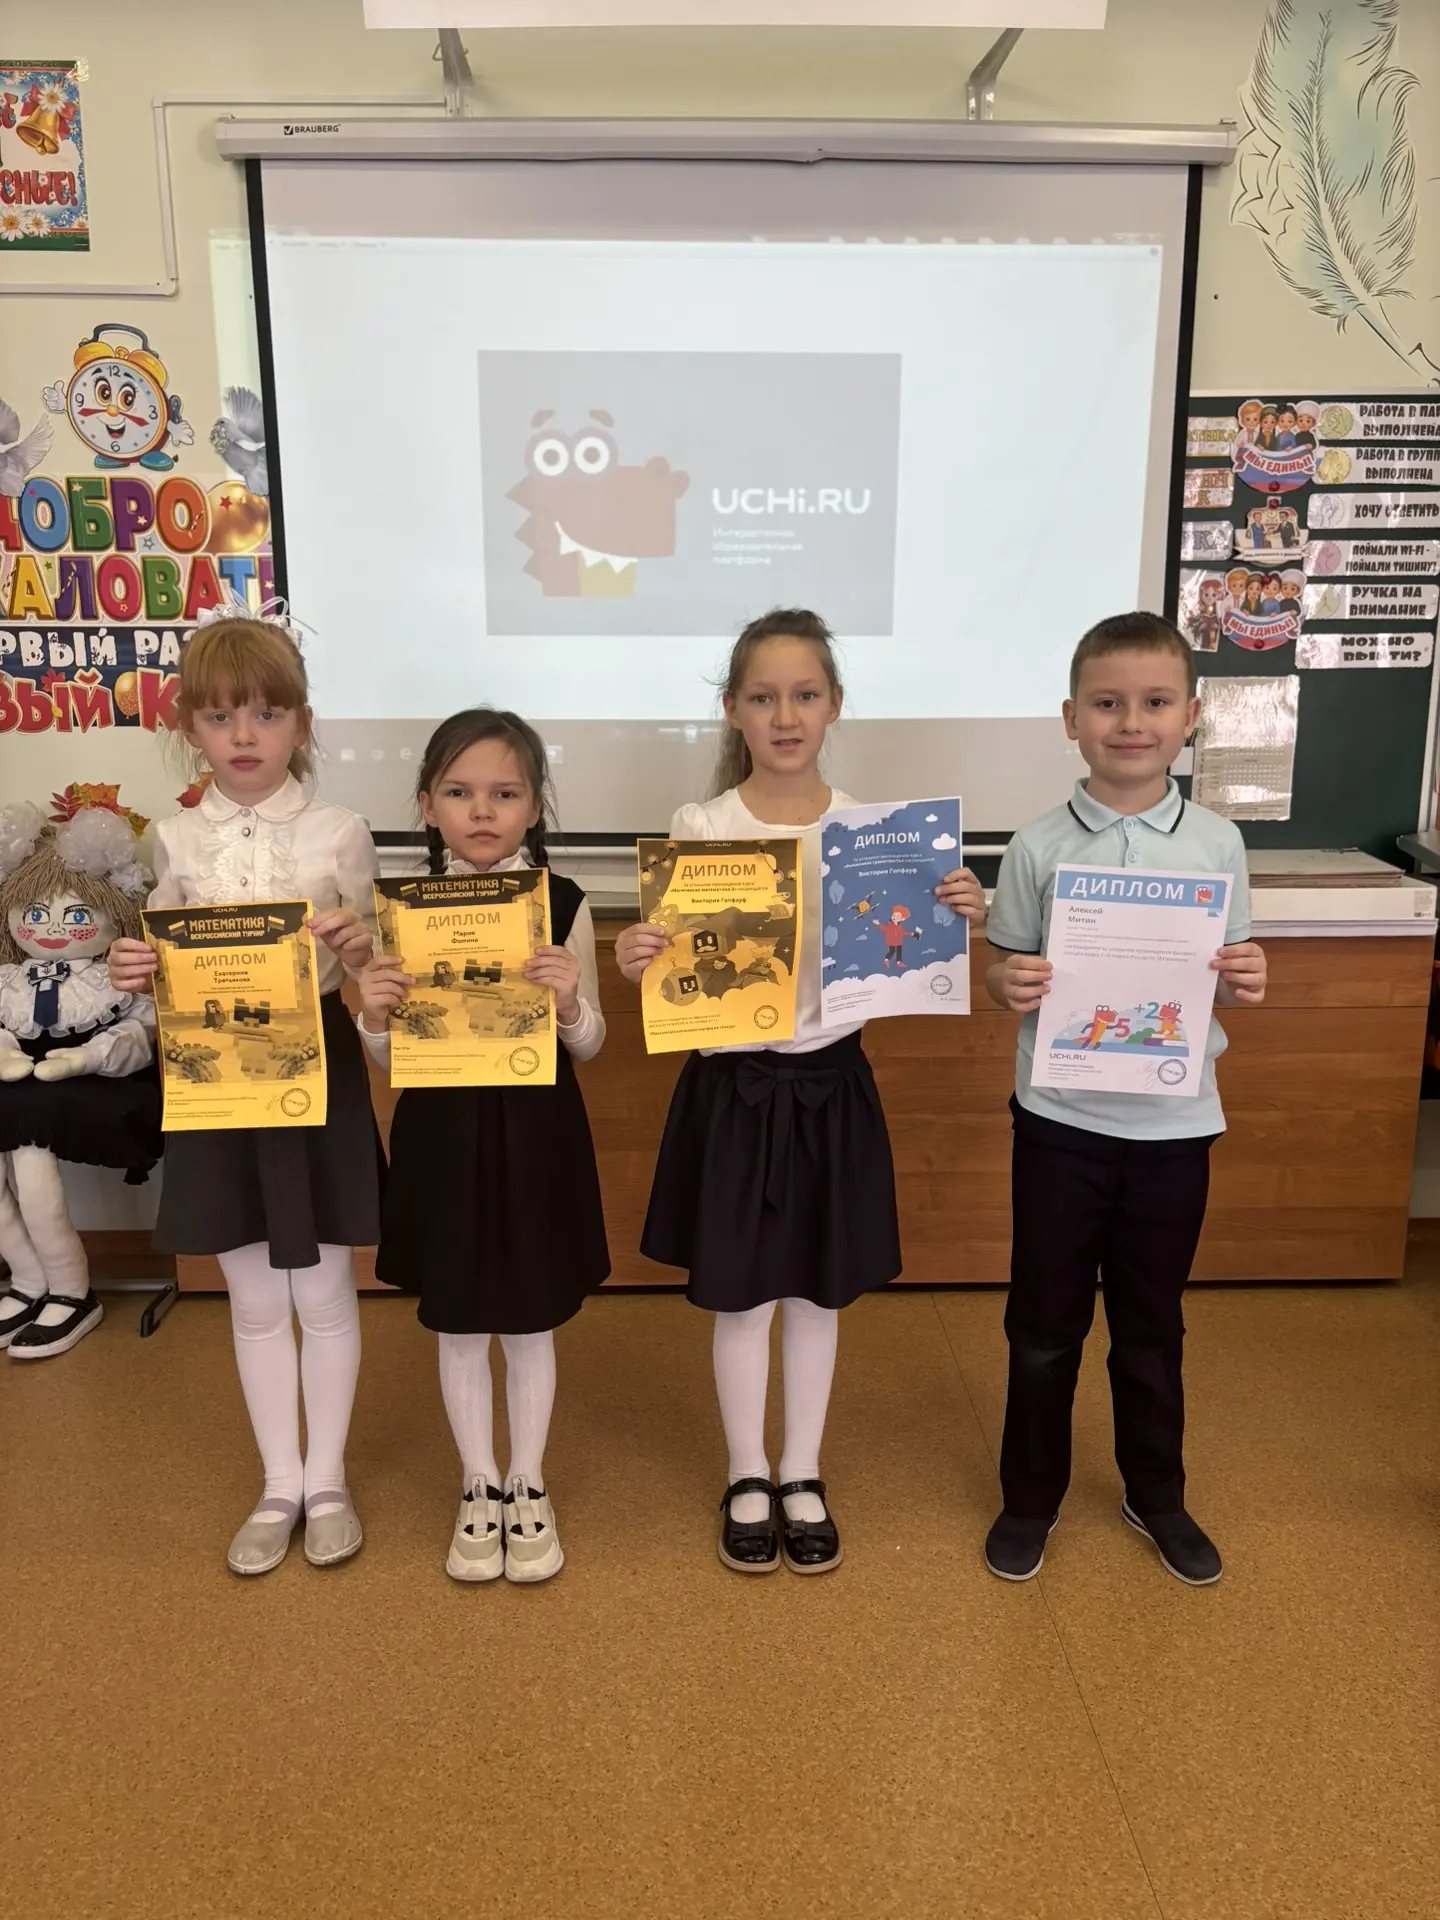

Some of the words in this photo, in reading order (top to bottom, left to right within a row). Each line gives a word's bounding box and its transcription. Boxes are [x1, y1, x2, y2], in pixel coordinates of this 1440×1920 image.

[295, 125, 339, 133] BRAUBERG
[1360, 405, 1405, 417] РАБОТА
[1409, 405, 1417, 417] В
[1245, 451, 1265, 468] МЫ
[1356, 448, 1395, 460] РАБОТА
[1365, 467, 1433, 480] ВЫПОЛНЕНА
[1355, 504, 1382, 518] ХОЧУ
[1353, 543, 1398, 555] ПОЙМАЛИ
[0, 554, 277, 622] АЛОВАТ
[1352, 586, 1398, 598] РУЧКА
[1402, 586, 1422, 598] НА
[1349, 604, 1426, 616] ВНИМАНИЕ
[854, 832, 920, 849] ДИПЛОМ
[681, 864, 756, 880] ДИПЛОМ
[422, 879, 499, 892] МАТЕМАТИКА
[1070, 877, 1184, 899] ДИПЛОМ
[1069, 906, 1103, 914] Алексей
[189, 917, 265, 931] МАТЕМАТИКА
[426, 912, 501, 930] ДИПЛОМ
[1068, 916, 1096, 924] Митин
[194, 953, 267, 970] ДИПЛОМ
